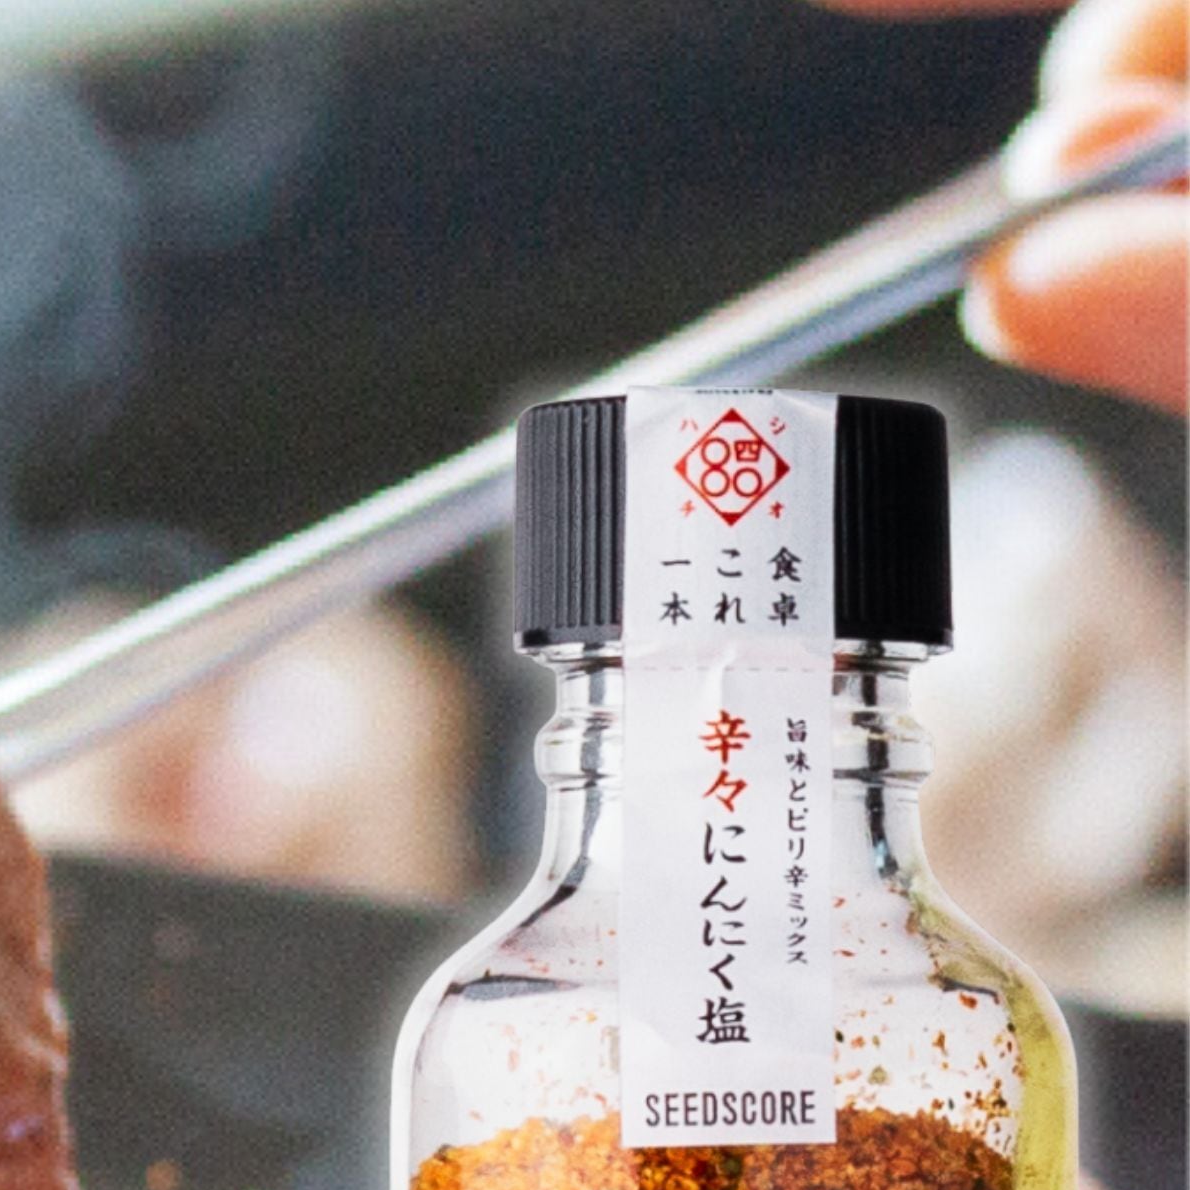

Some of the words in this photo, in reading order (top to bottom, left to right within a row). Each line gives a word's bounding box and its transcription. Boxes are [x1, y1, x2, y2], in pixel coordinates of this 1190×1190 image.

[660, 558, 693, 626] 一本
[713, 549, 746, 625] これ
[768, 546, 803, 627] 食卓
[696, 709, 752, 1045] 辛々にんにく塩
[783, 717, 811, 966] 旨味とピリ辛ミックス
[645, 1090, 816, 1128] SEEDSCORE
